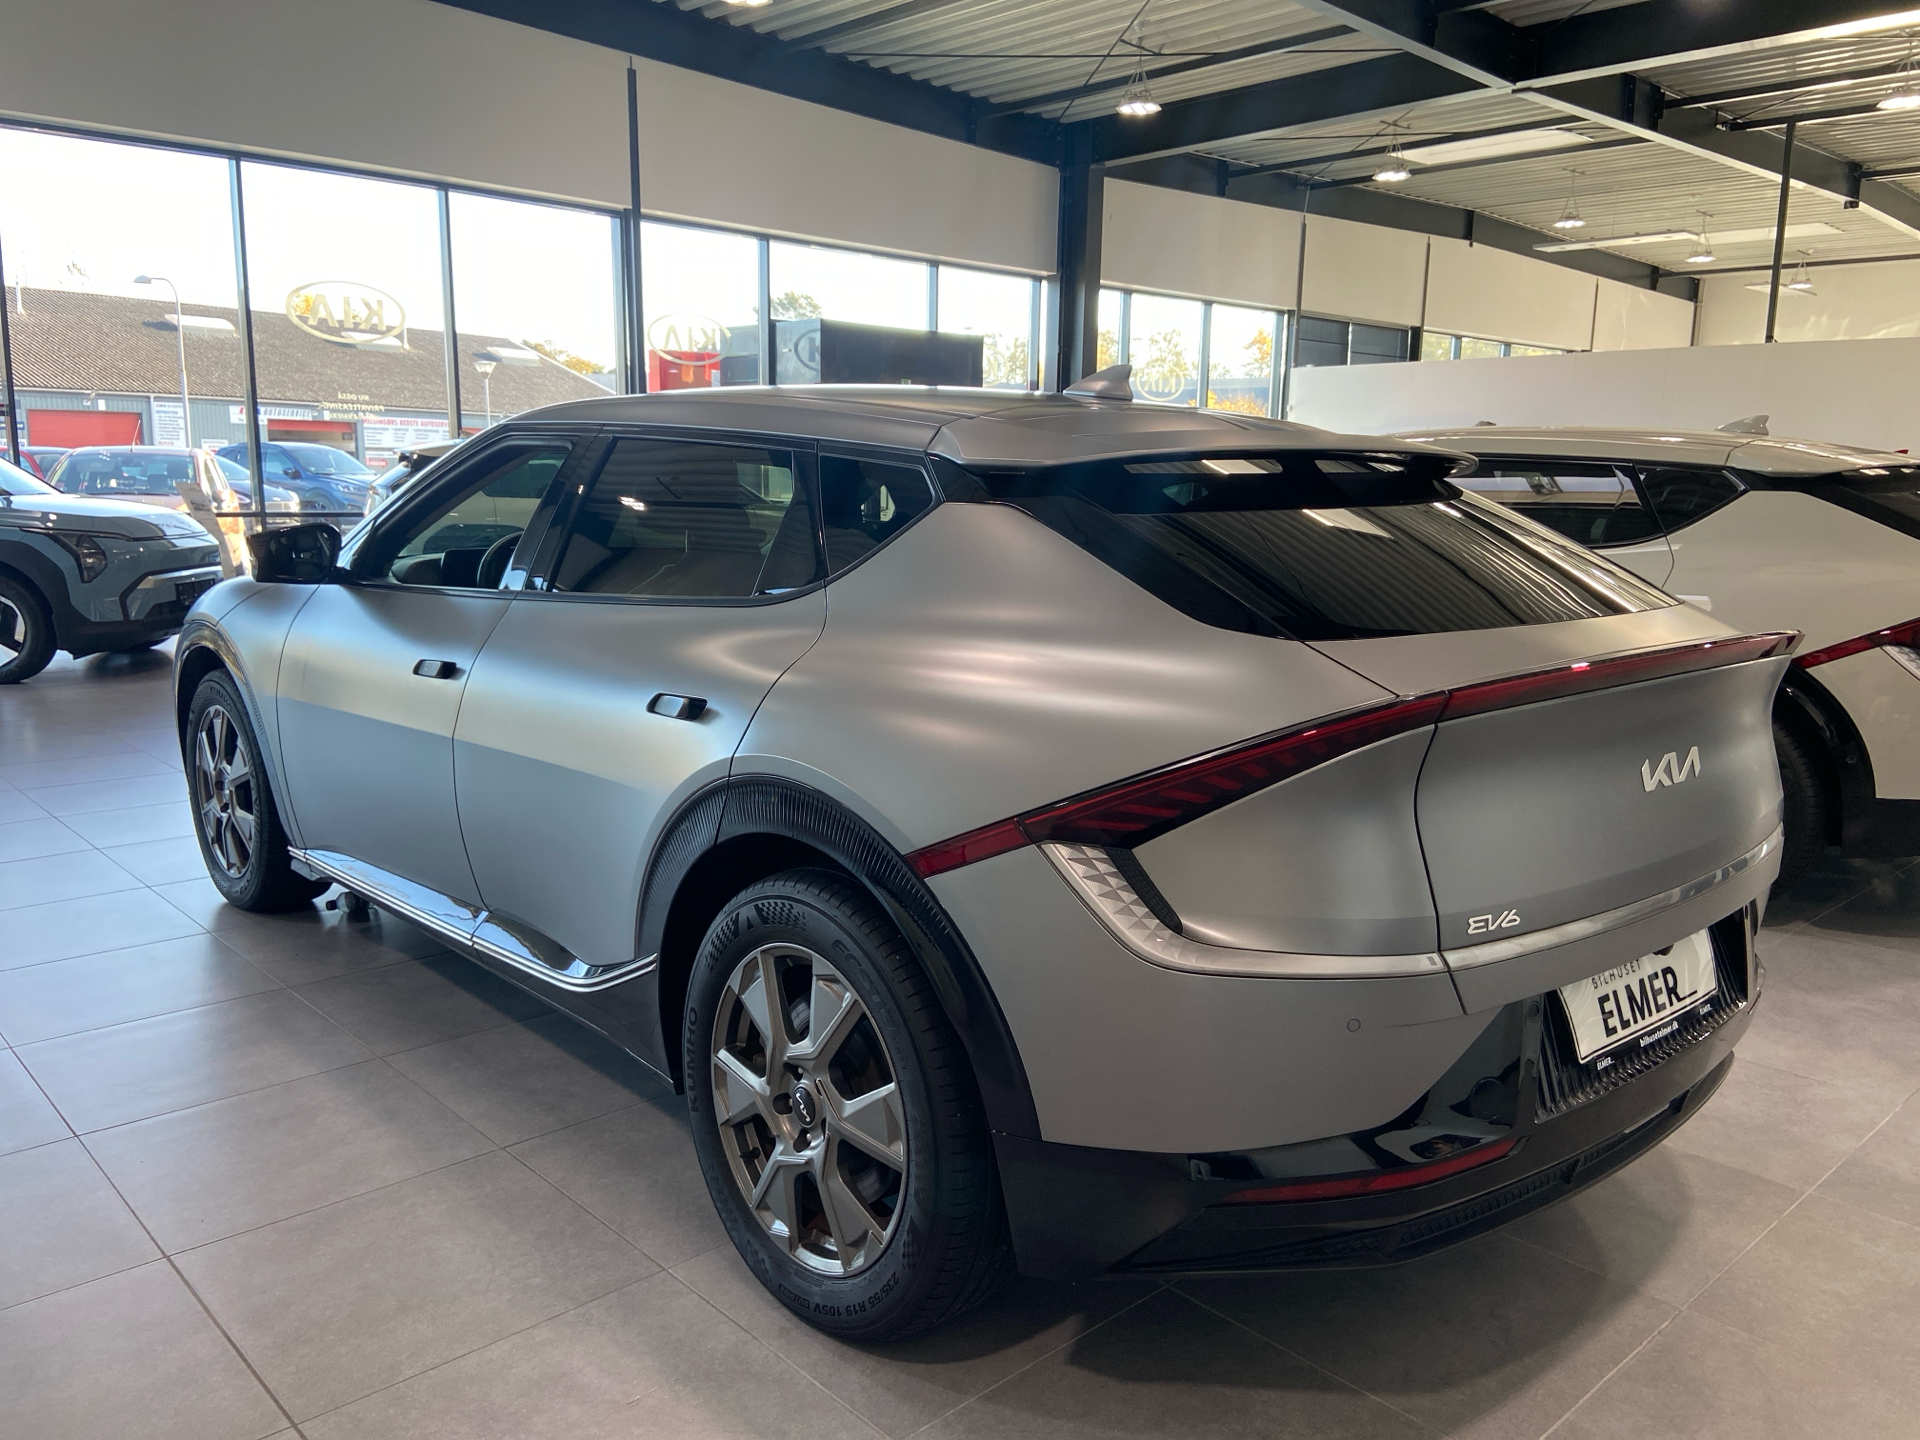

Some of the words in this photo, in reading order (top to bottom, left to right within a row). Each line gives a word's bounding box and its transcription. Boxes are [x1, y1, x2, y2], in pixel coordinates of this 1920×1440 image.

[263, 408, 311, 418] AUTOSERVICE
[399, 419, 419, 427] BEDSTE
[1641, 745, 1701, 792] KIA
[1467, 909, 1521, 935] EV6
[1591, 959, 1641, 990] BILHUSET
[687, 1006, 699, 1113] KUMHO
[867, 1271, 900, 1309] 235/55
[813, 1302, 843, 1317] 105V
[845, 1300, 867, 1316] R19
